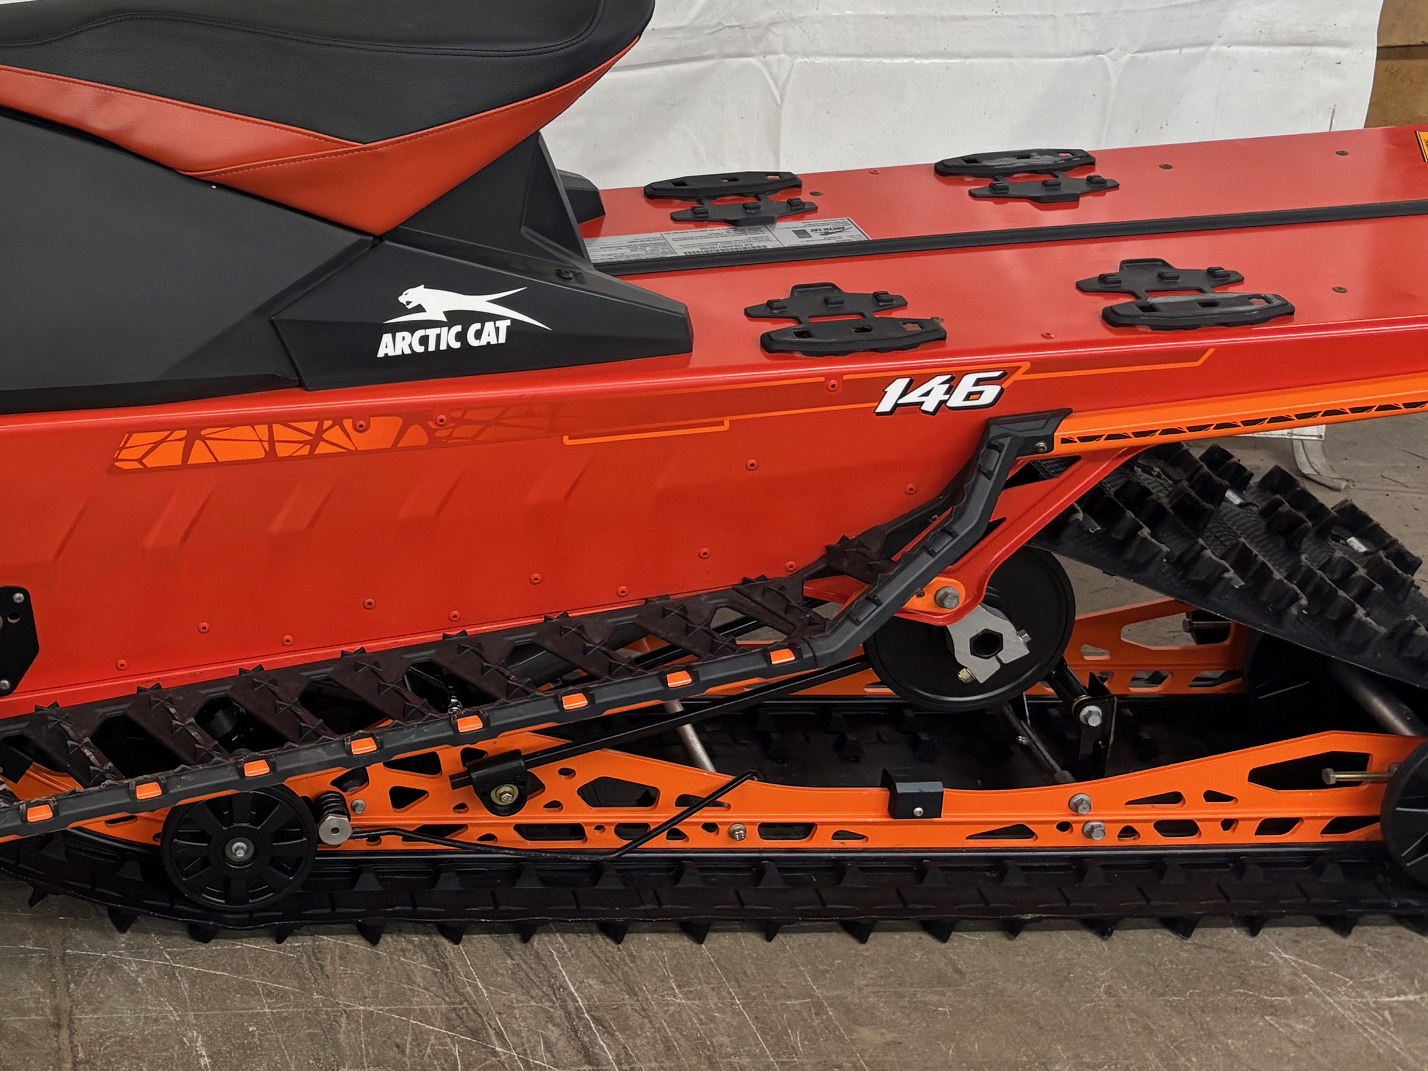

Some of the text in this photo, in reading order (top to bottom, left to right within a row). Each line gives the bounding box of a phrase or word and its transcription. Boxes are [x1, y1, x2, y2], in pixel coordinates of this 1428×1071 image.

[376, 319, 511, 358] ARCTIC CAT
[874, 370, 1008, 415] 146
